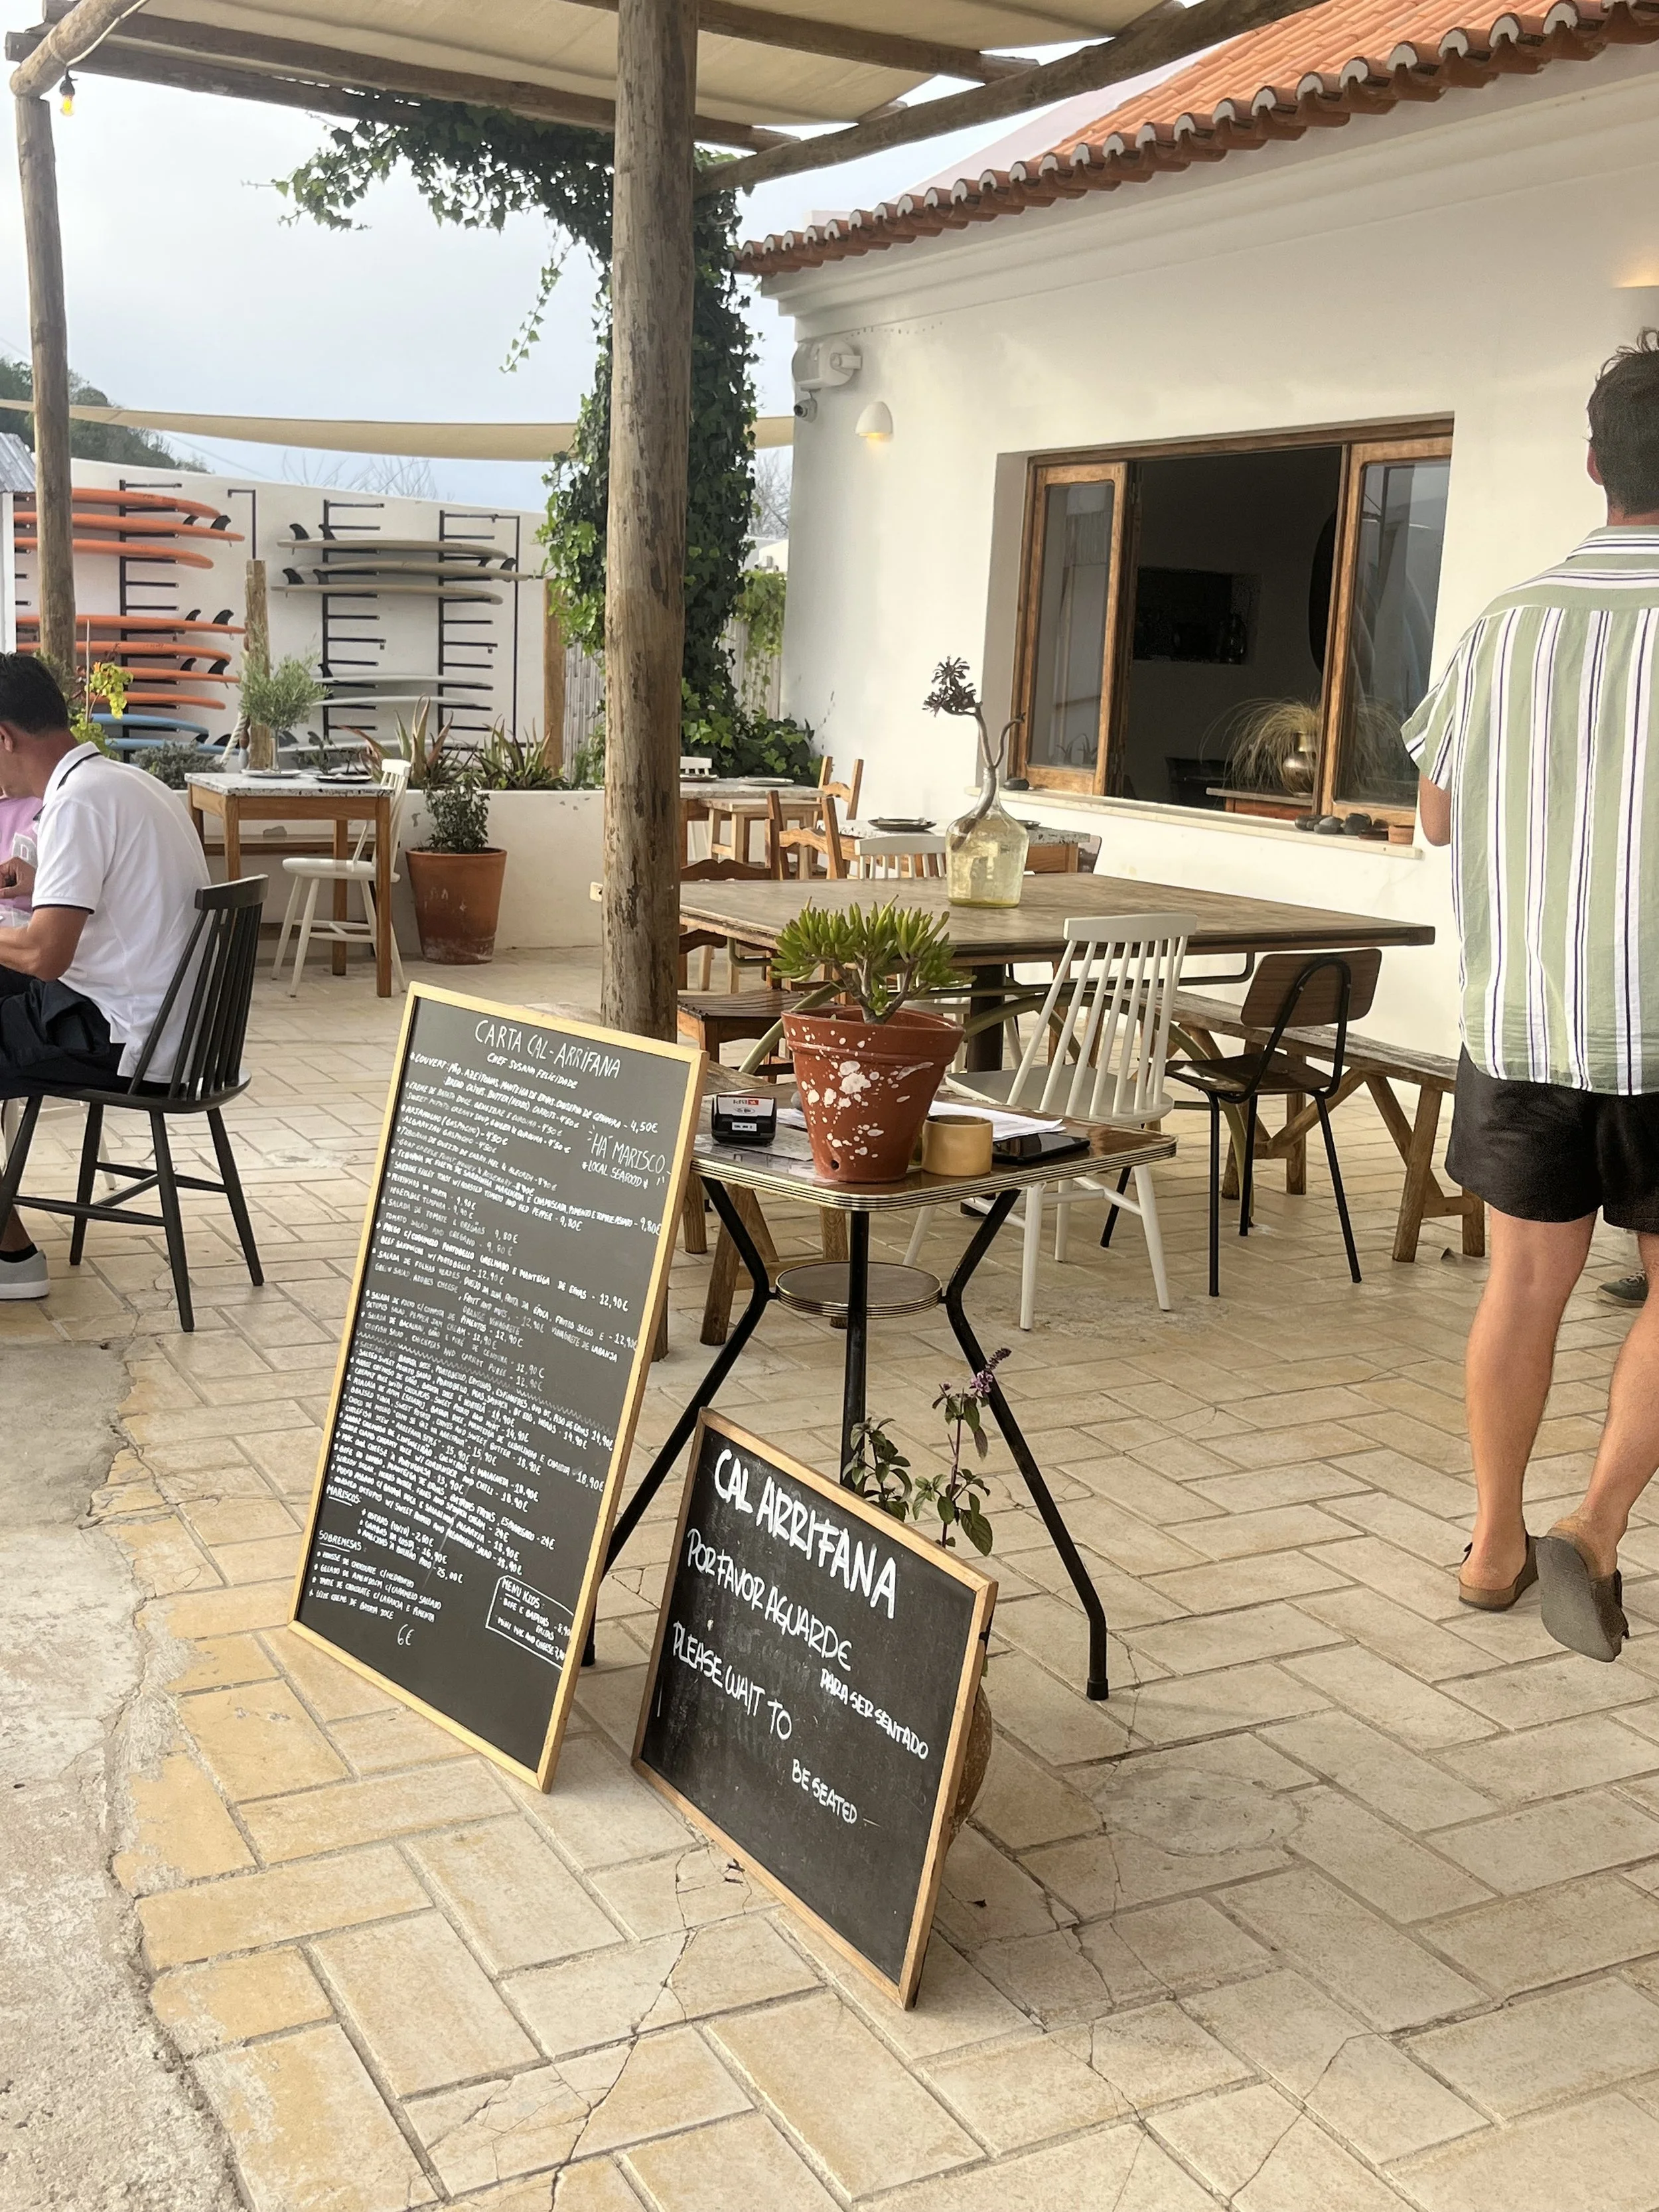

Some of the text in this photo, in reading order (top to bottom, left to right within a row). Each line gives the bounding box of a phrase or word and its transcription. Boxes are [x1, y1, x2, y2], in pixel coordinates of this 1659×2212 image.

[475, 1019, 522, 1053] CARTA
[487, 1053, 508, 1066] CHEF
[508, 1059, 536, 1075] SUSANA
[588, 1160, 642, 1187] LOCAL SEAFOOD
[591, 1133, 665, 1178] HÁ MARISCO
[715, 1449, 897, 1619] CAL ARRIFANA
[502, 1578, 522, 1597] MENU
[687, 1528, 852, 1671] POR FAVOR AGUARDE
[397, 1624, 414, 1645] 6€
[672, 1621, 792, 1741] PLEASE WAIT TO
[820, 1668, 929, 1760] PARA SER SENTADO
[791, 1758, 858, 1824] BE SEATED
